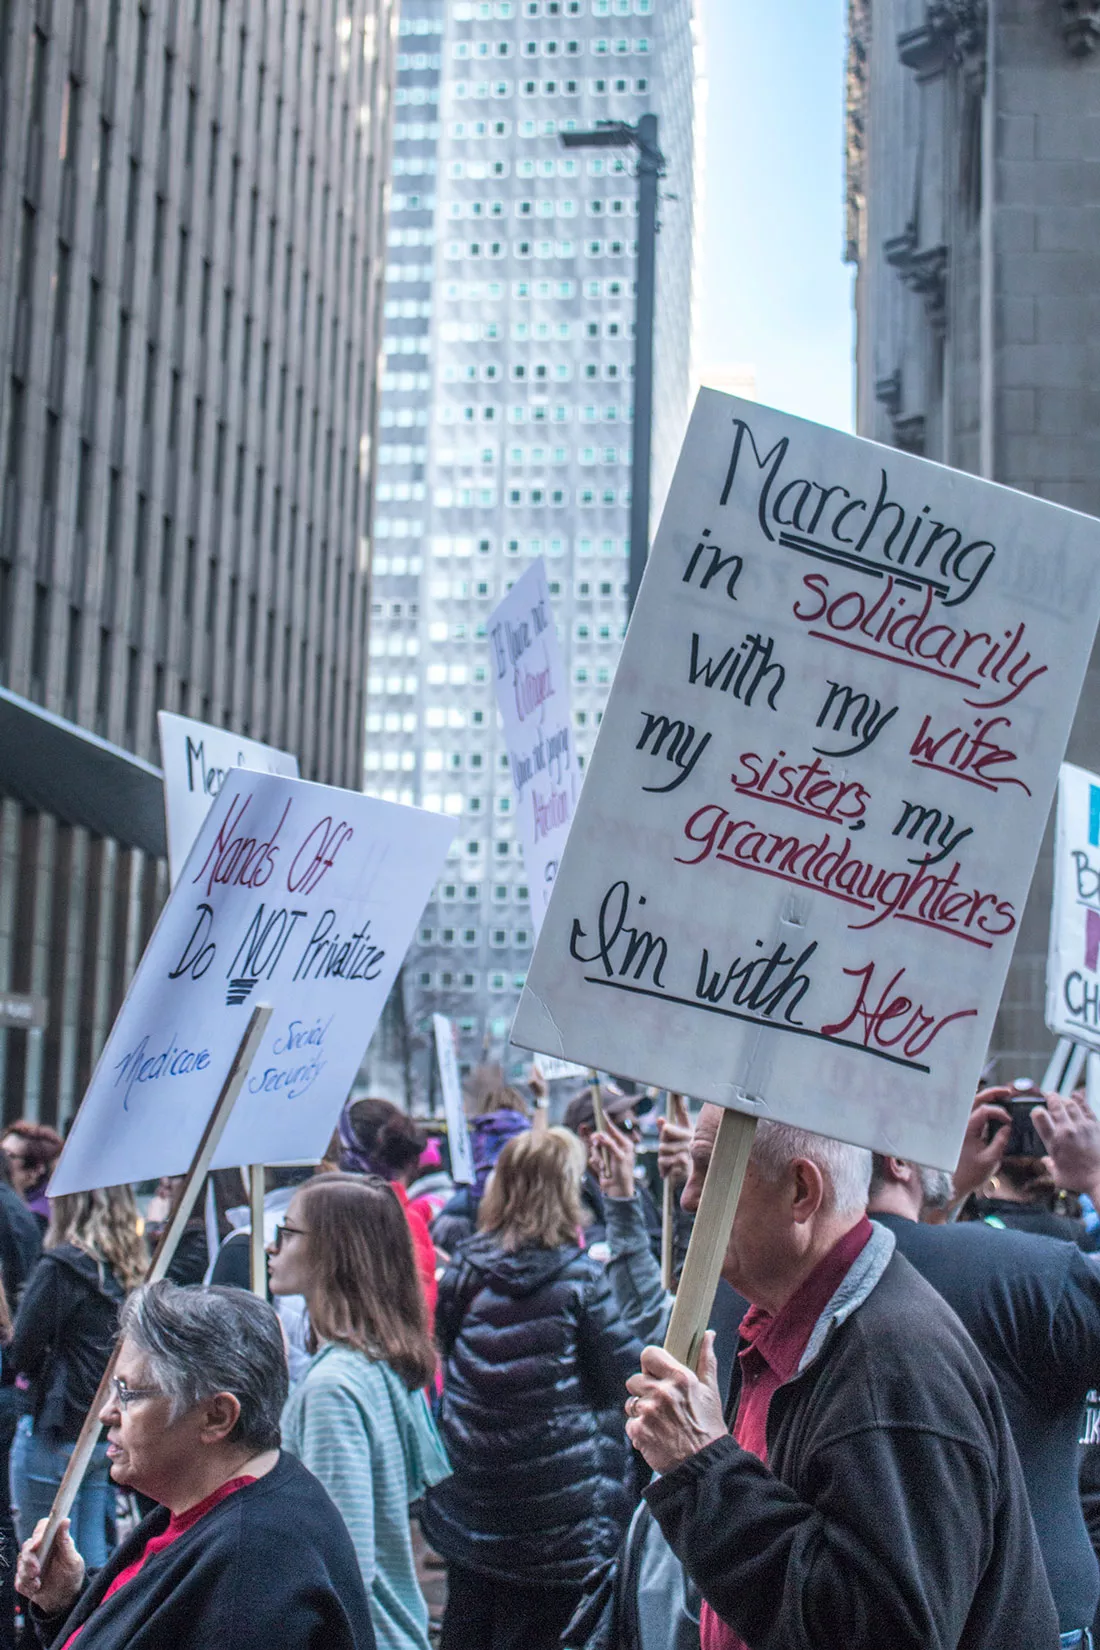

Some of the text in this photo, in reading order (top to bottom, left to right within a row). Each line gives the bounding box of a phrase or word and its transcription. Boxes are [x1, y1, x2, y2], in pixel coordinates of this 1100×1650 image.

[682, 528, 744, 600] in
[719, 418, 996, 607] Marching
[688, 632, 1032, 796] with my wife
[192, 792, 353, 897] Hands Off
[635, 711, 974, 866] my sisters, my
[674, 803, 1017, 936] granddaughters
[168, 903, 386, 982] Do NOT Privatize
[695, 939, 818, 1025] with
[821, 961, 978, 1058] Her
[115, 1033, 211, 1112] Medicare
[249, 1049, 328, 1099] Security
